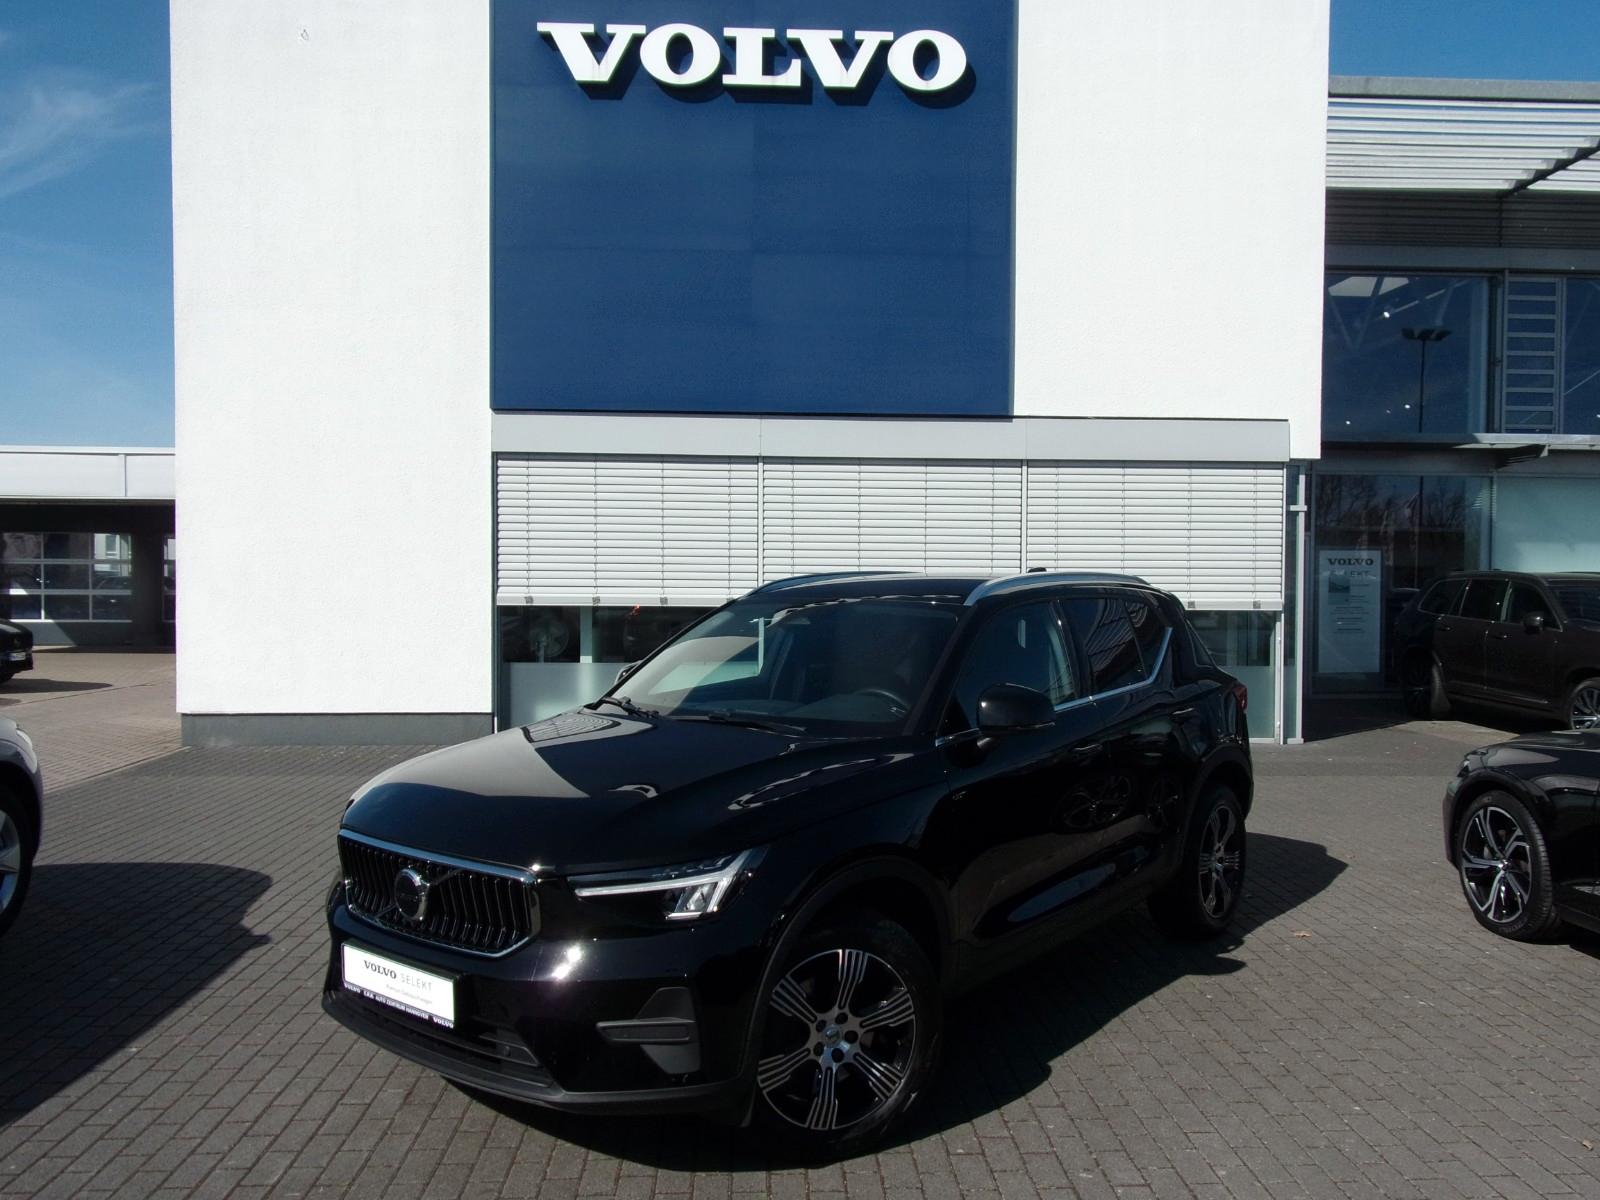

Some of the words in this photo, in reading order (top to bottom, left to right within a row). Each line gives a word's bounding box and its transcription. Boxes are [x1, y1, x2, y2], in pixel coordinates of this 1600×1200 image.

[537, 22, 967, 91] VOLVO
[1327, 557, 1375, 566] VOLVO
[363, 959, 397, 980] VOLVO
[400, 972, 433, 992] SELEKT
[432, 1015, 455, 1029] VOLVO
